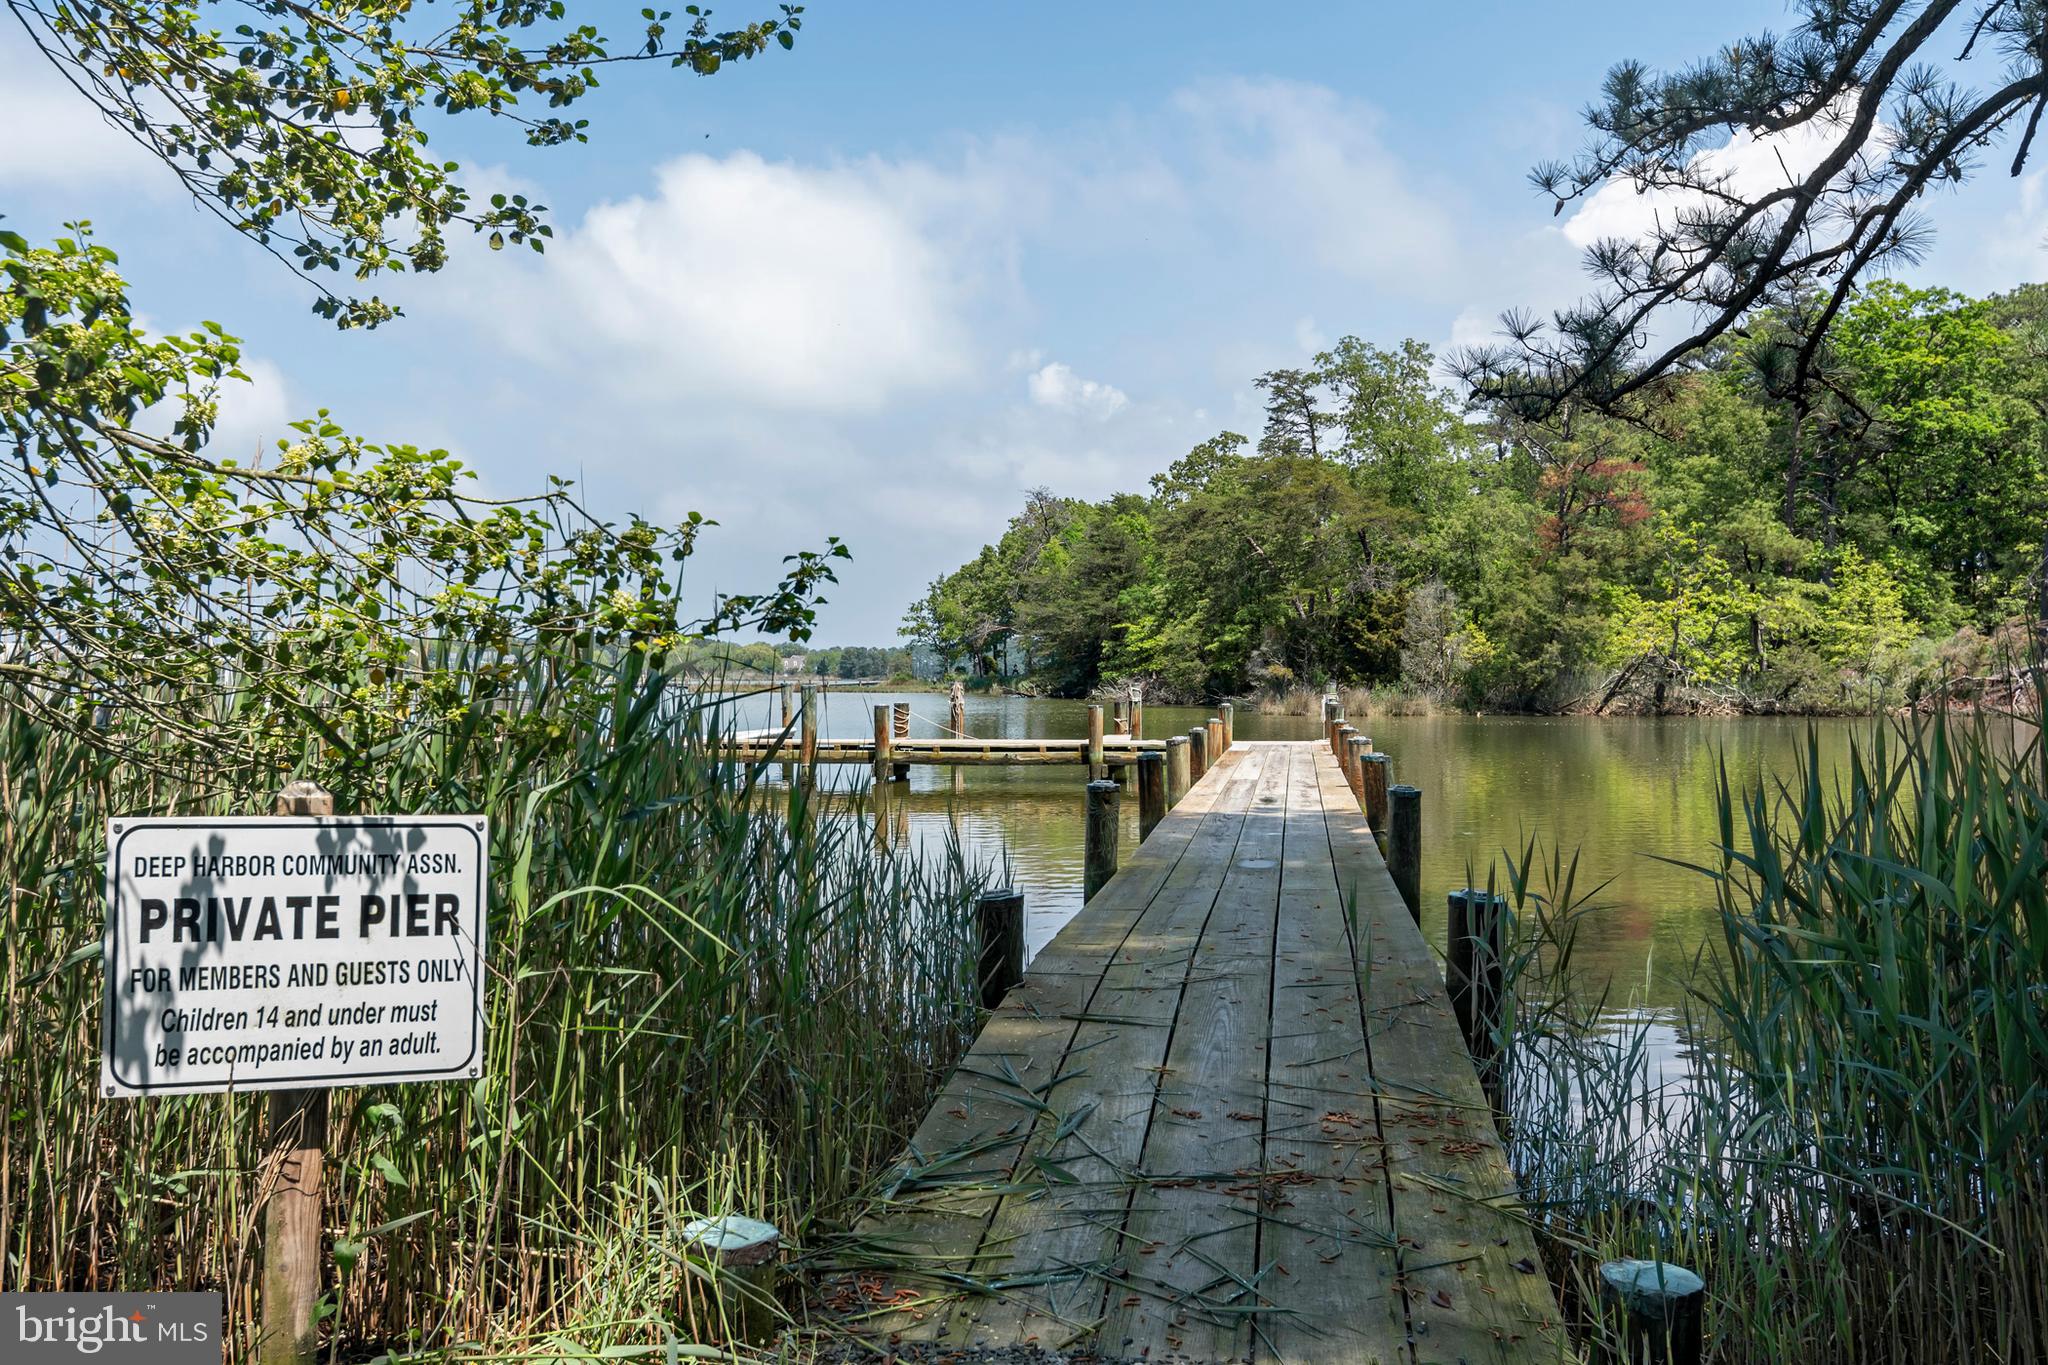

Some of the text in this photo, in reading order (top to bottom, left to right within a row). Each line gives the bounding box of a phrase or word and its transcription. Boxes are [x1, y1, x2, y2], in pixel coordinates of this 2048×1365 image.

[134, 853, 462, 878] DEEP HARBOR COMMUNITY ASSN.
[140, 893, 460, 943] PRIVATE PIER
[131, 959, 464, 993] FOR MEMBERS AND GUESTS ONLY
[161, 1000, 438, 1033] Children 14 and under must
[155, 1032, 440, 1068] be accompanied by an adult.
